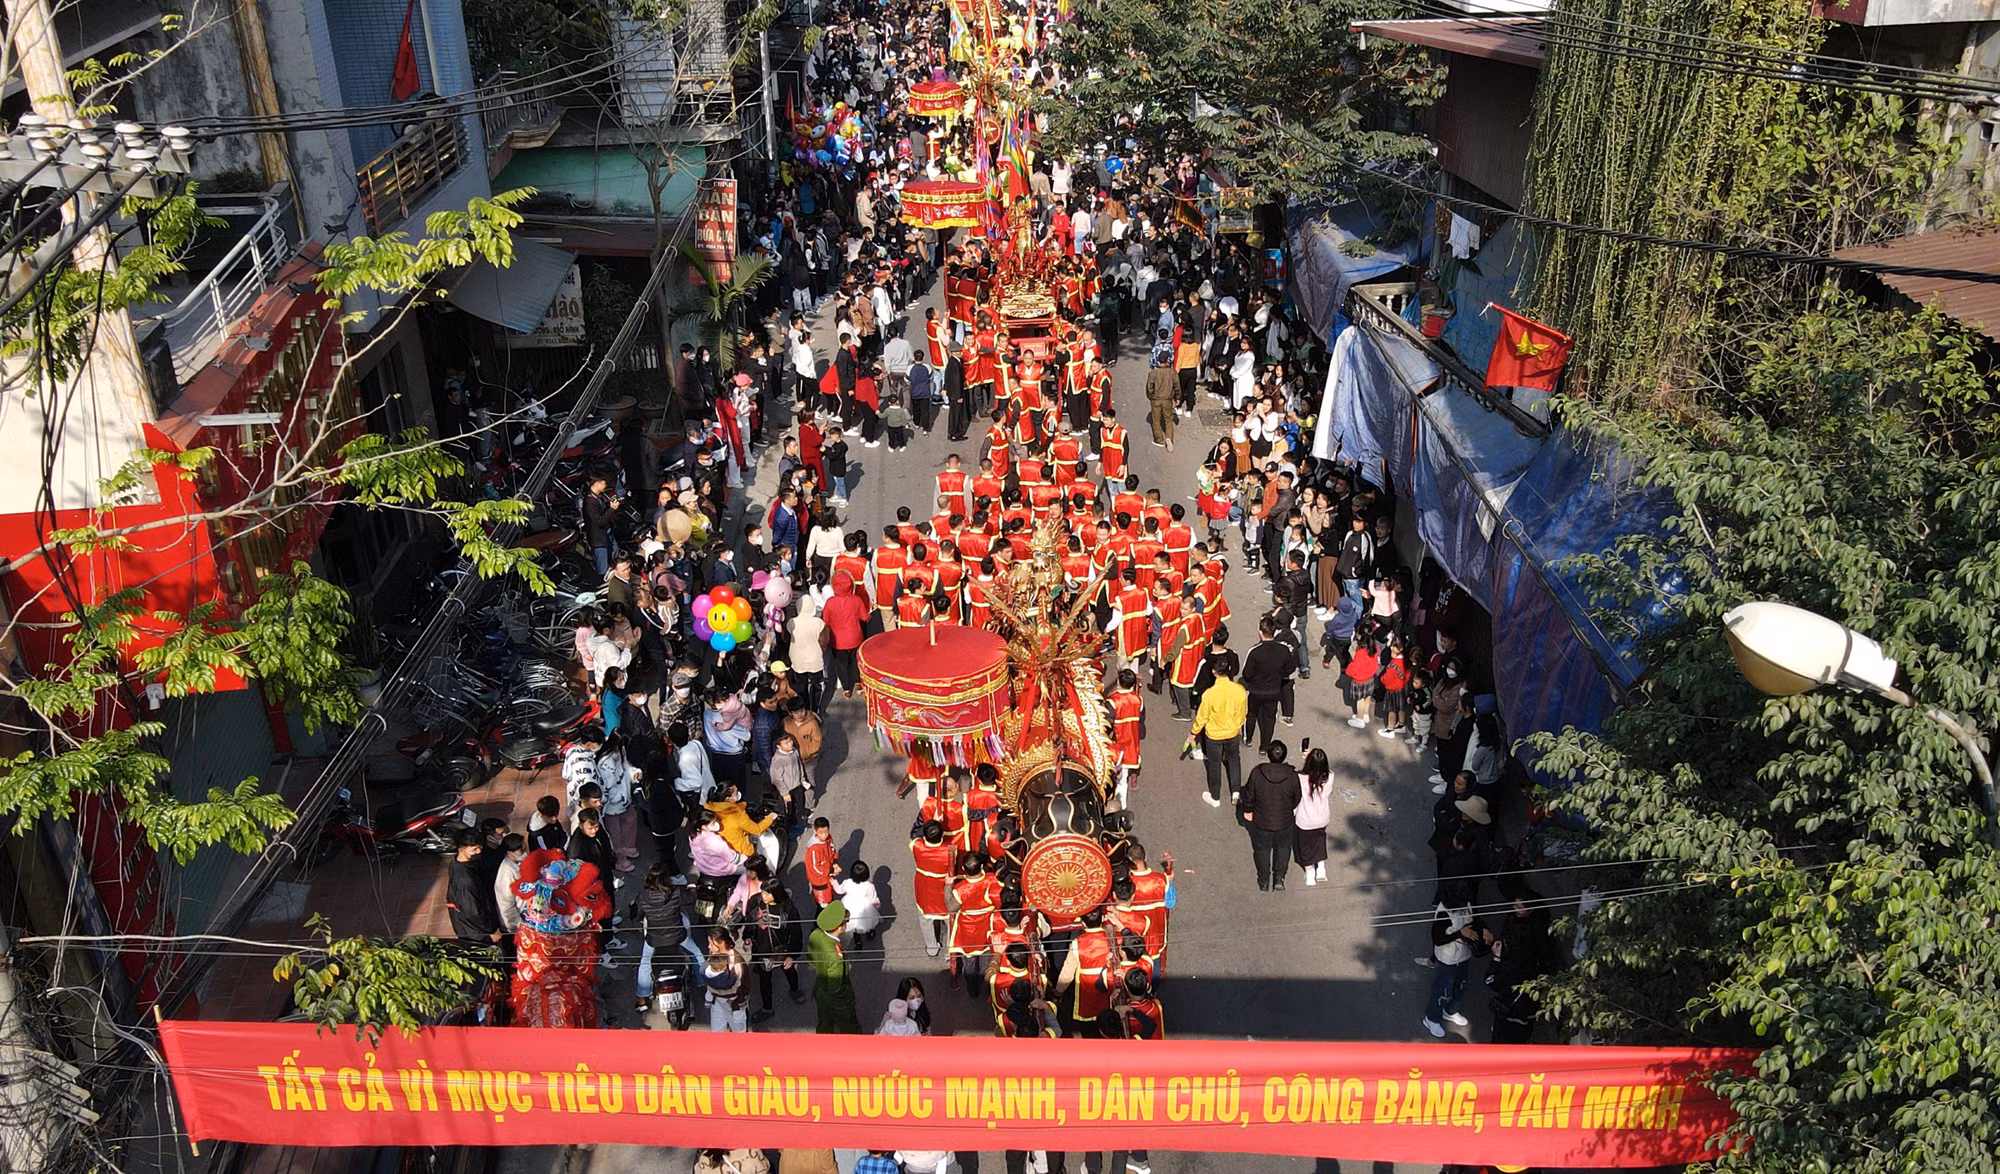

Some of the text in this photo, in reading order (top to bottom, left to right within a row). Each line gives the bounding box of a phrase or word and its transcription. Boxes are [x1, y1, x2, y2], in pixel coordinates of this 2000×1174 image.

[258, 1050, 1685, 1133] TẤT CẢ VÌ MỤC TIÊU DÂN GIÀU, NƯỚC MẠNH, DÂN CHỦ, CÔNG BẰNG, VĂN MINH
